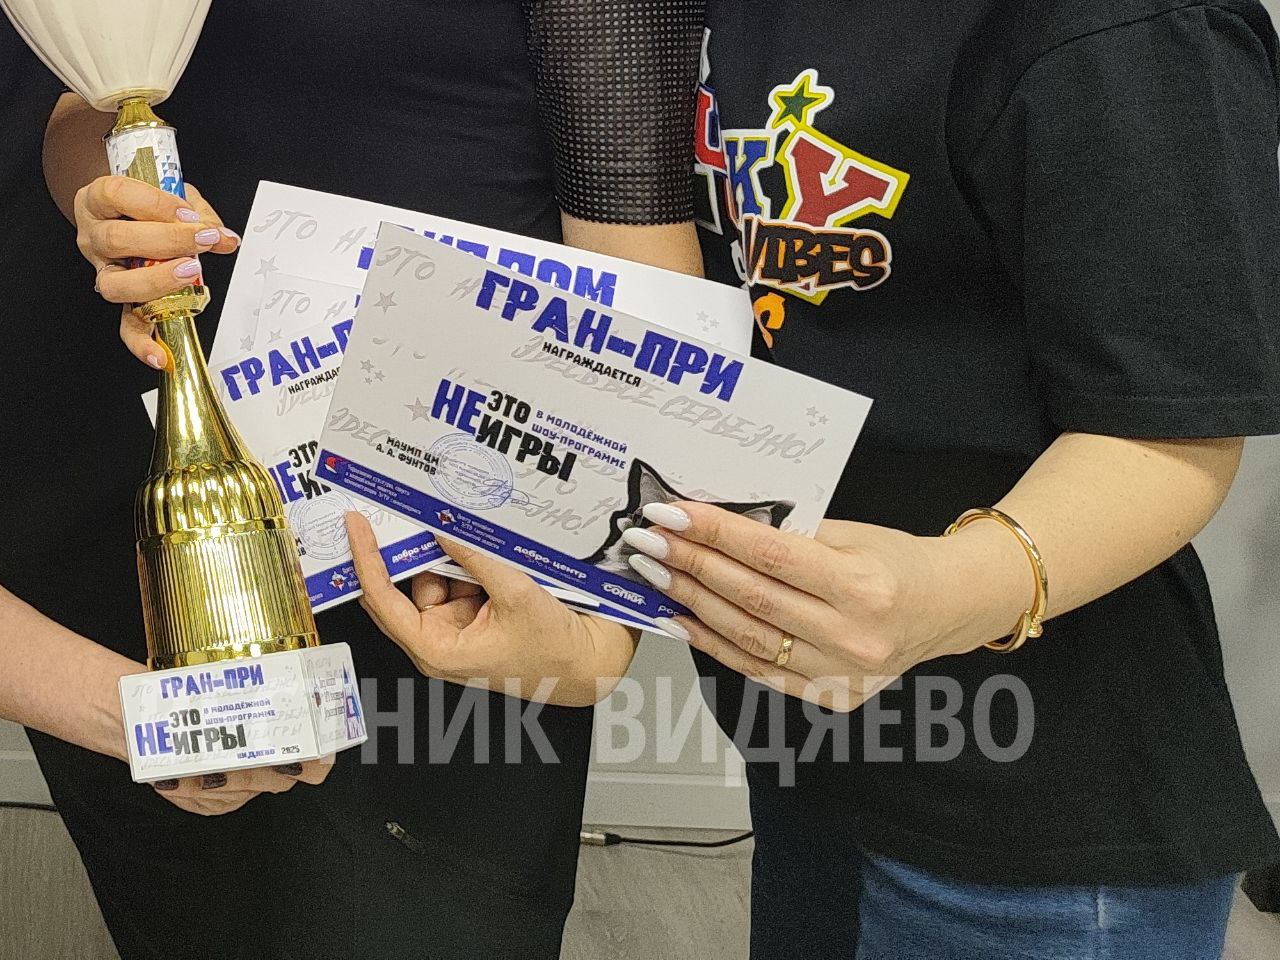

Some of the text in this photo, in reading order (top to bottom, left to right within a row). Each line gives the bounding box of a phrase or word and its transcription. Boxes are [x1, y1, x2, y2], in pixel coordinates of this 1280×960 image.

[475, 269, 744, 403] ГРАН-ПРИ
[221, 319, 353, 402] ГРАН-П
[542, 341, 642, 387] НАГРАЖДАЕТСЯ
[487, 390, 531, 424] ЭТО
[430, 378, 487, 436] НЕ
[475, 414, 577, 482] ИГРЫ
[531, 423, 627, 470] ШОУ-ПРОГРАММЕ
[546, 413, 627, 454] МОЛОДЁЖНОЙ
[386, 436, 440, 465] МАУМП ЦМ
[397, 452, 437, 476] ФУНТОВ
[160, 664, 265, 699] ГРАН-ПРИ
[169, 708, 201, 728] ЭТО
[134, 720, 173, 757] НЕ
[173, 724, 247, 755] ИГРЫ
